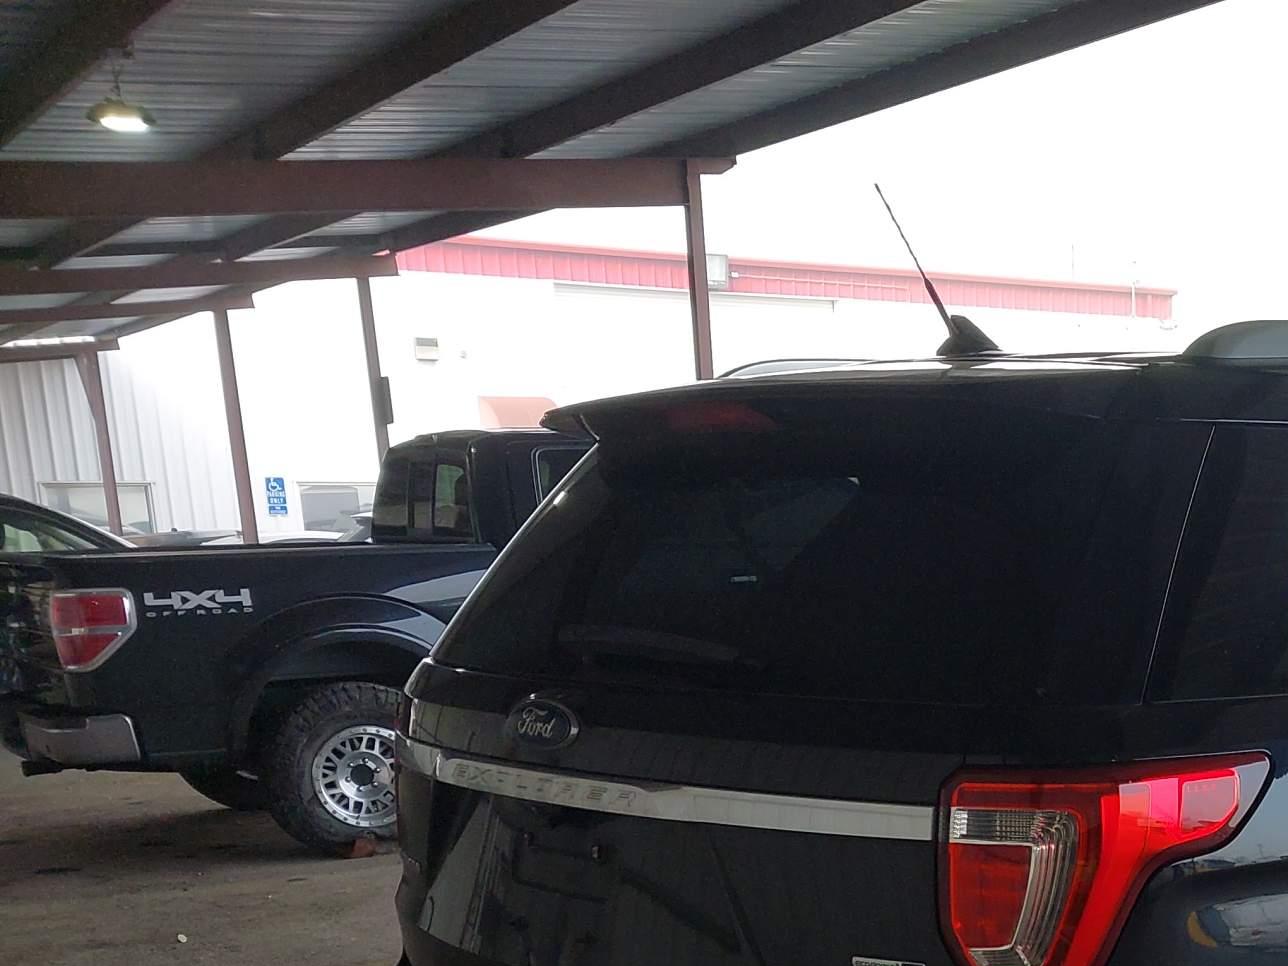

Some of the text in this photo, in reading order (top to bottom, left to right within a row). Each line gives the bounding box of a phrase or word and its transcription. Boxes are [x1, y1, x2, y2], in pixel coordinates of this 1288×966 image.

[145, 606, 254, 618] OFF ROAD
[517, 706, 556, 738] Ford
[453, 762, 637, 808] EXPLORER
